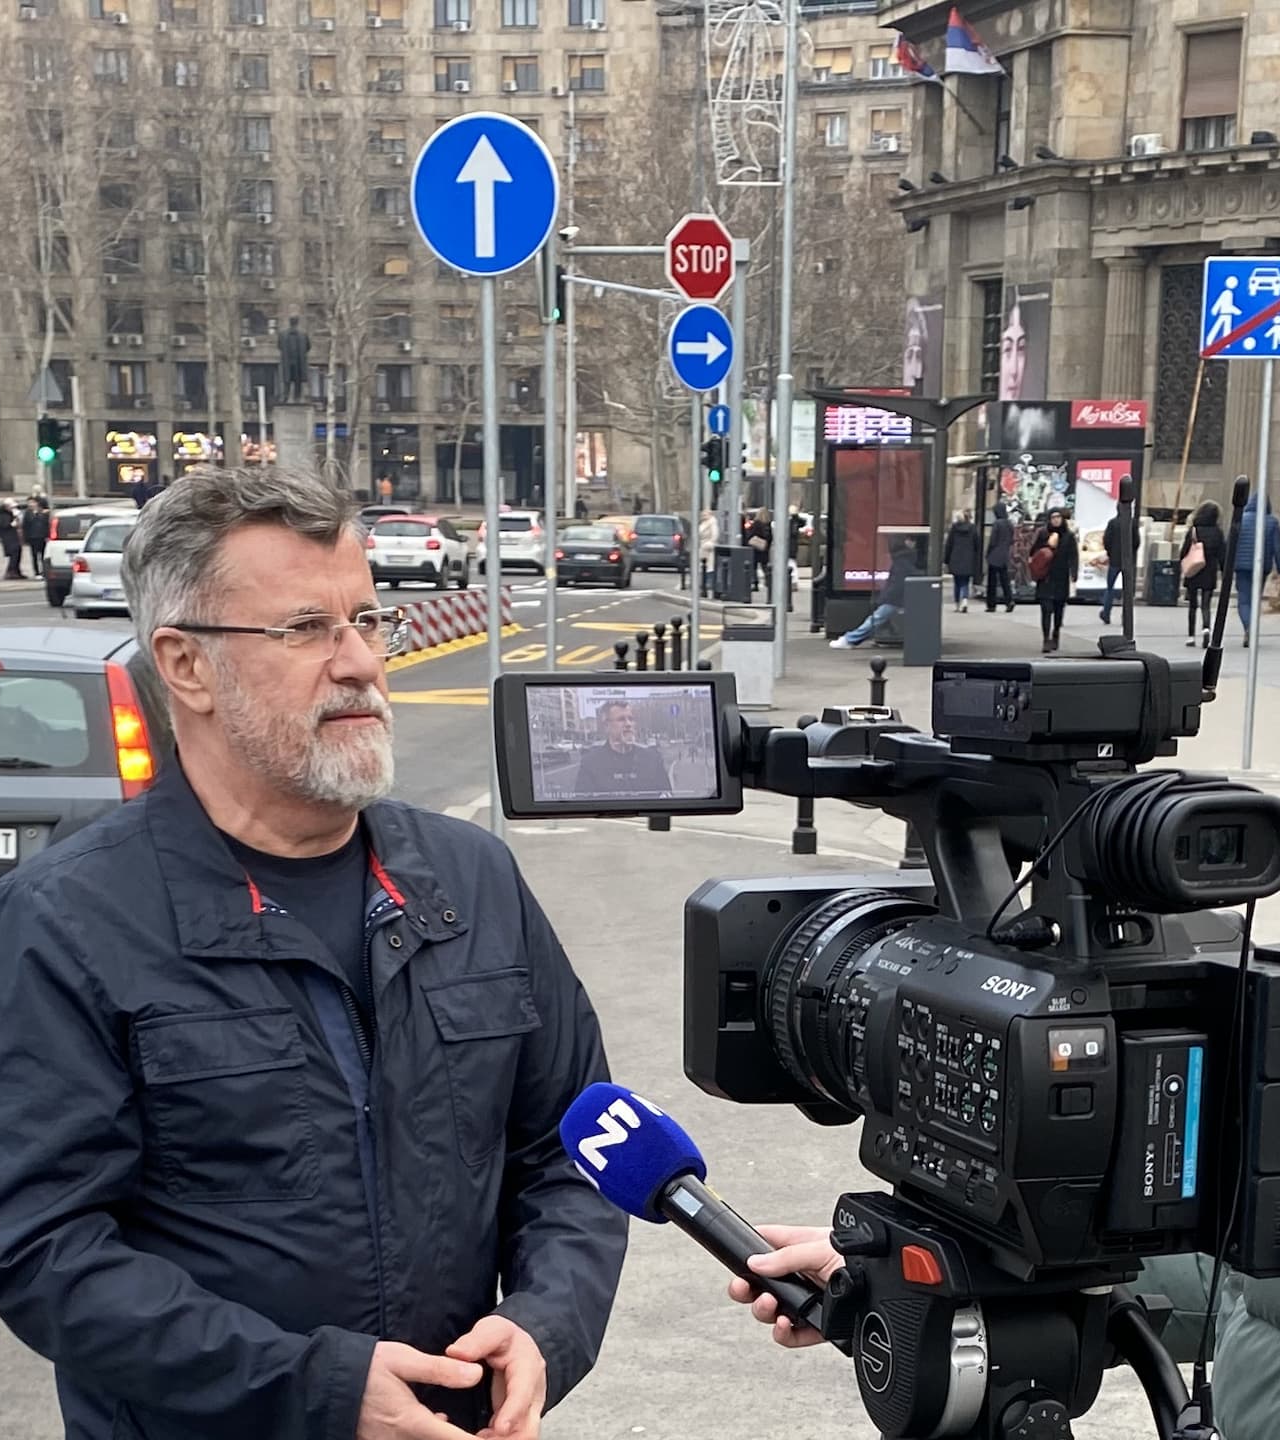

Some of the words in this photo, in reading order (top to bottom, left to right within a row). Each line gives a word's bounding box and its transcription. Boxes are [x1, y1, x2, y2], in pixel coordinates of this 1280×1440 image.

[674, 244, 728, 274] STOP
[895, 937, 922, 951] 4K
[980, 975, 1037, 1001] SONY
[1144, 1150, 1155, 1197] SONY
[977, 1334, 984, 1342] 2
[977, 1366, 984, 1374] 3
[1041, 1409, 1047, 1417] 4
